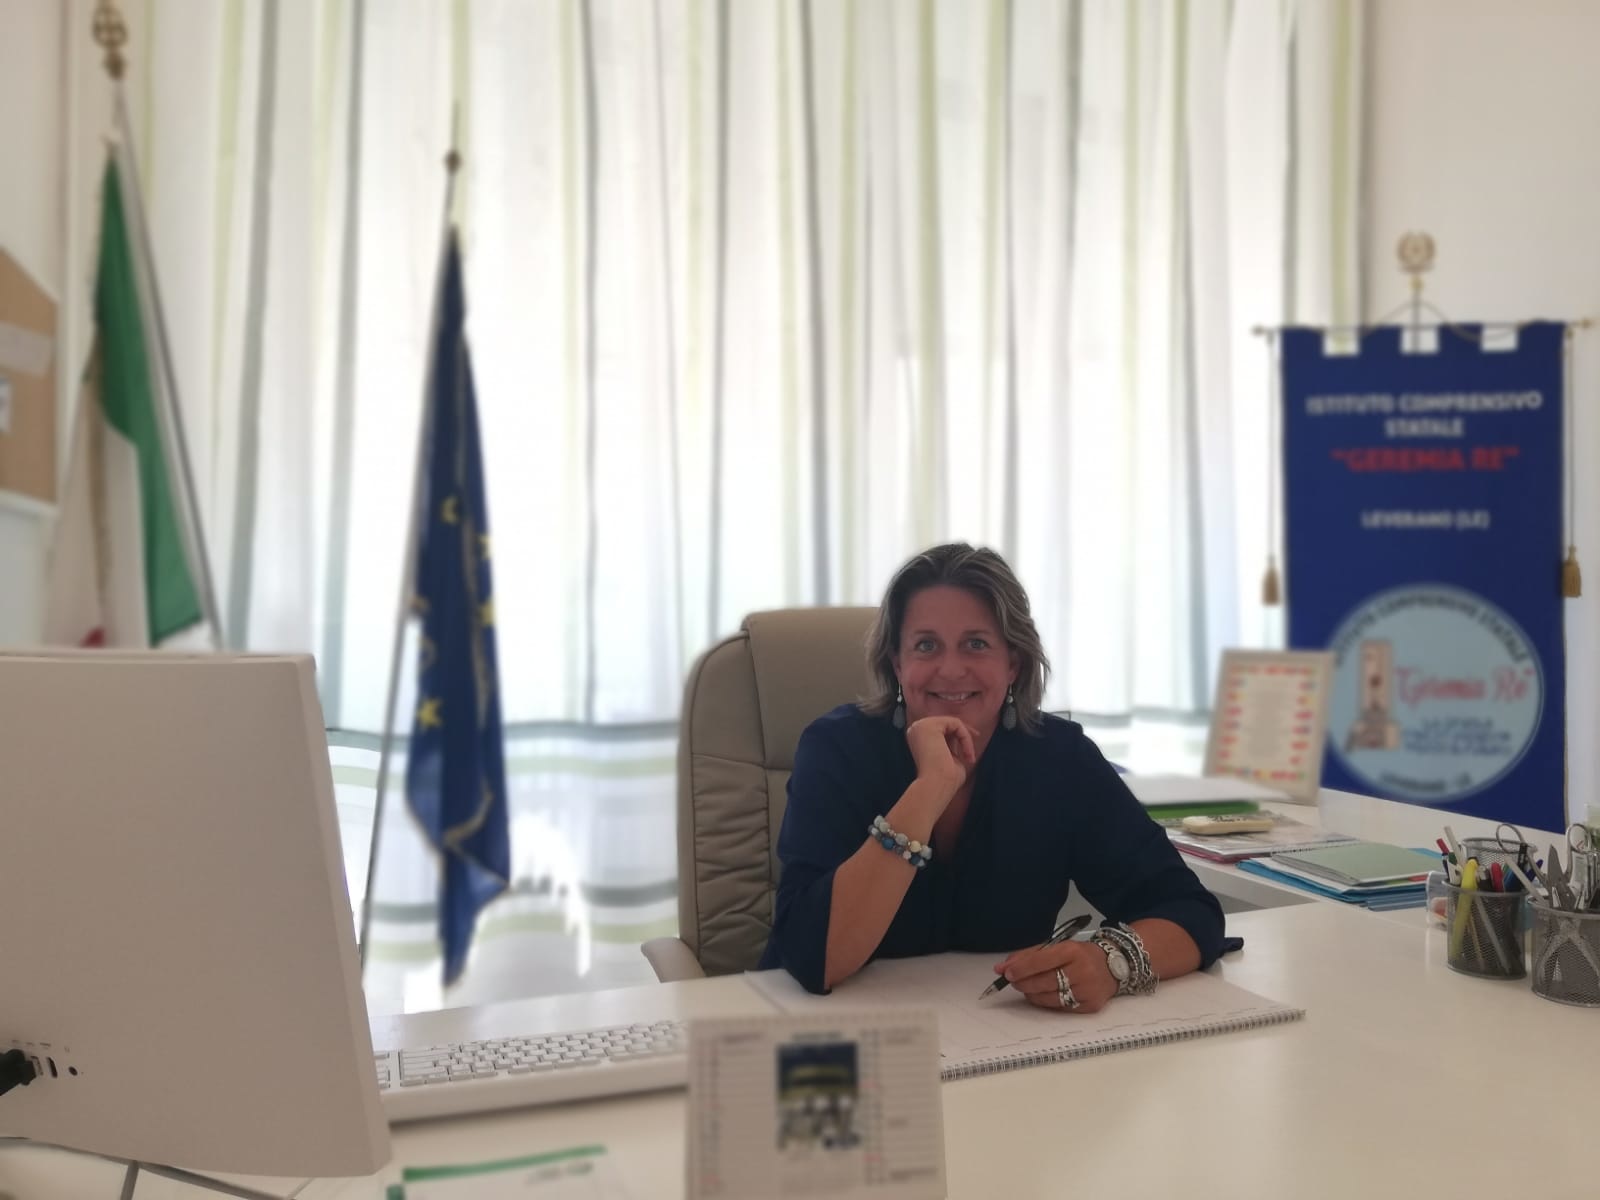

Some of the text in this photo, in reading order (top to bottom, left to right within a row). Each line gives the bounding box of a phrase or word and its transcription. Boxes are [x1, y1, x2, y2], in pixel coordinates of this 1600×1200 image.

[1306, 391, 1543, 415] ISTITUTO COMPRENSIVO
[1384, 418, 1465, 438] STATALE
[1361, 509, 1490, 530] LEVERANO (LE)
